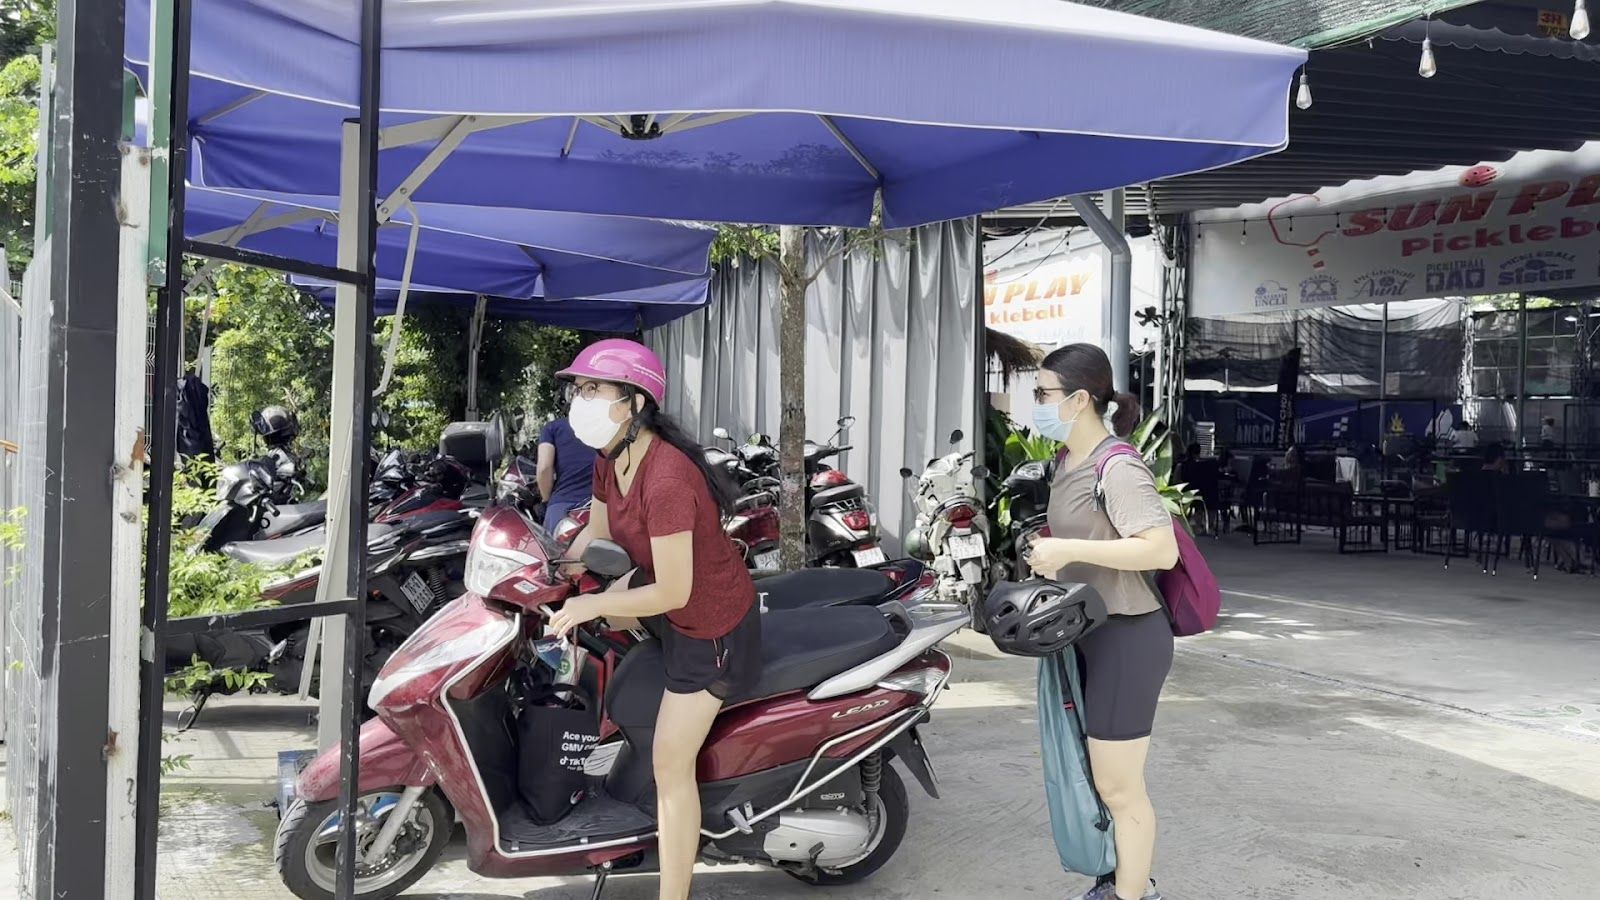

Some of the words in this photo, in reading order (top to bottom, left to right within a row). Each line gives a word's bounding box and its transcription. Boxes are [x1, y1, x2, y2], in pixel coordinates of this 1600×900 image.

[1341, 190, 1499, 237] SUN
[1401, 217, 1600, 257] Pickleb
[1003, 272, 1092, 304] PLAY
[1346, 277, 1409, 299] Aunt
[1426, 268, 1485, 293] DAD
[1255, 296, 1288, 307] UNCLE
[990, 304, 1064, 324] kleball
[832, 700, 890, 718] LEAD
[562, 731, 580, 740] Ace
[561, 742, 584, 751] GMV
[569, 757, 585, 766] TikT
